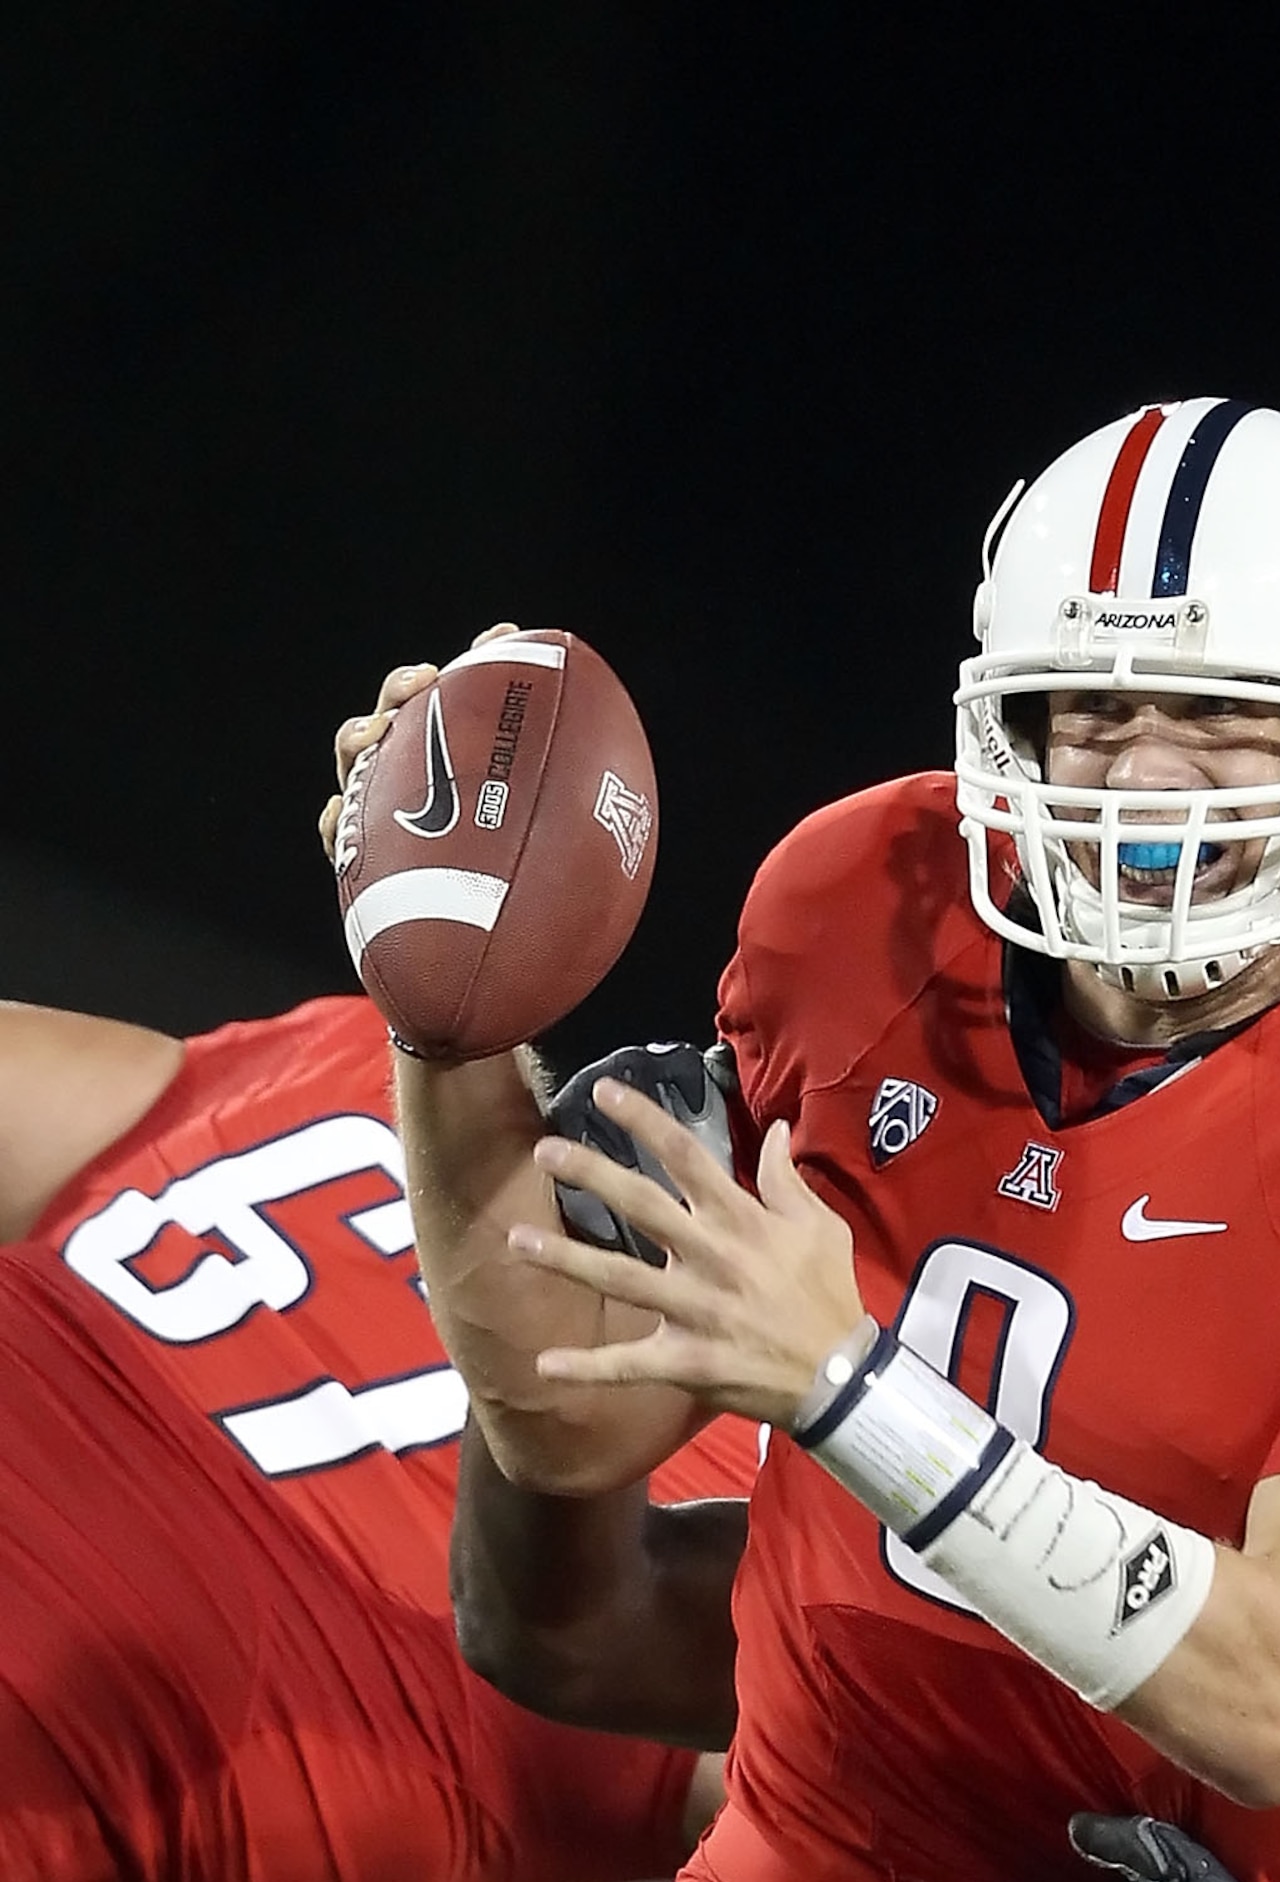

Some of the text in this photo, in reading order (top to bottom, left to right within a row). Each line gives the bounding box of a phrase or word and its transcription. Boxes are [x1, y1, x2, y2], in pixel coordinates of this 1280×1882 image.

[1094, 612, 1175, 629] ARIZONA
[477, 680, 533, 827] 3005 COLLEGIATE
[868, 1077, 938, 1143] PAC
[872, 1114, 910, 1154] 10
[997, 1140, 1063, 1211] A
[1126, 1542, 1169, 1611] PRO
